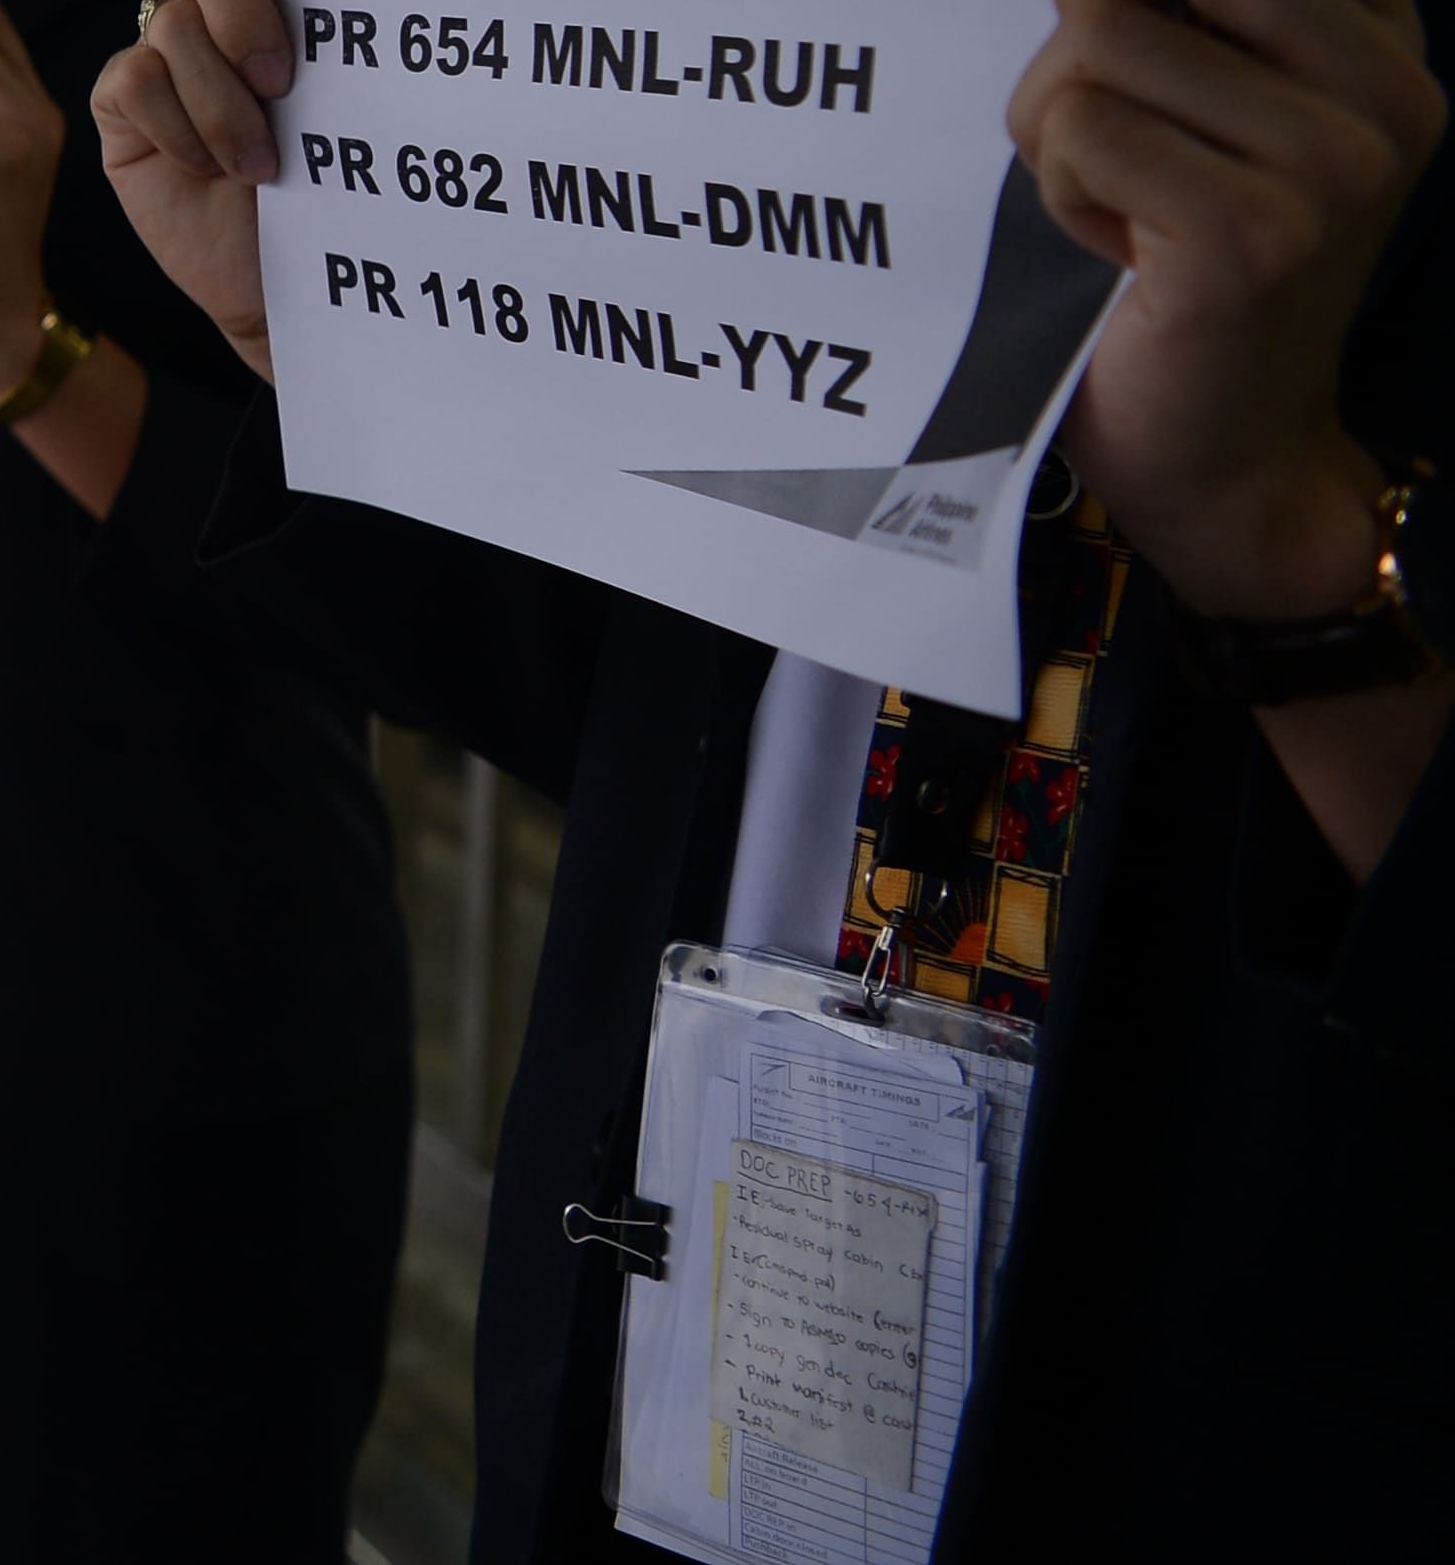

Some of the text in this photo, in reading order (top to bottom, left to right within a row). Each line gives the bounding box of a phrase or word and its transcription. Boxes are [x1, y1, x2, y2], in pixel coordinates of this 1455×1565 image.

[301, 6, 876, 115] PR 654 MNL-RUH
[299, 132, 893, 270] PR 682 MNL-DMM
[324, 252, 873, 419] PR 118 MNL-YYZ
[807, 1073, 922, 1108] AIRCRAFT TIMINGS
[739, 1149, 780, 1180] DOC
[787, 1165, 832, 1197] PREP
